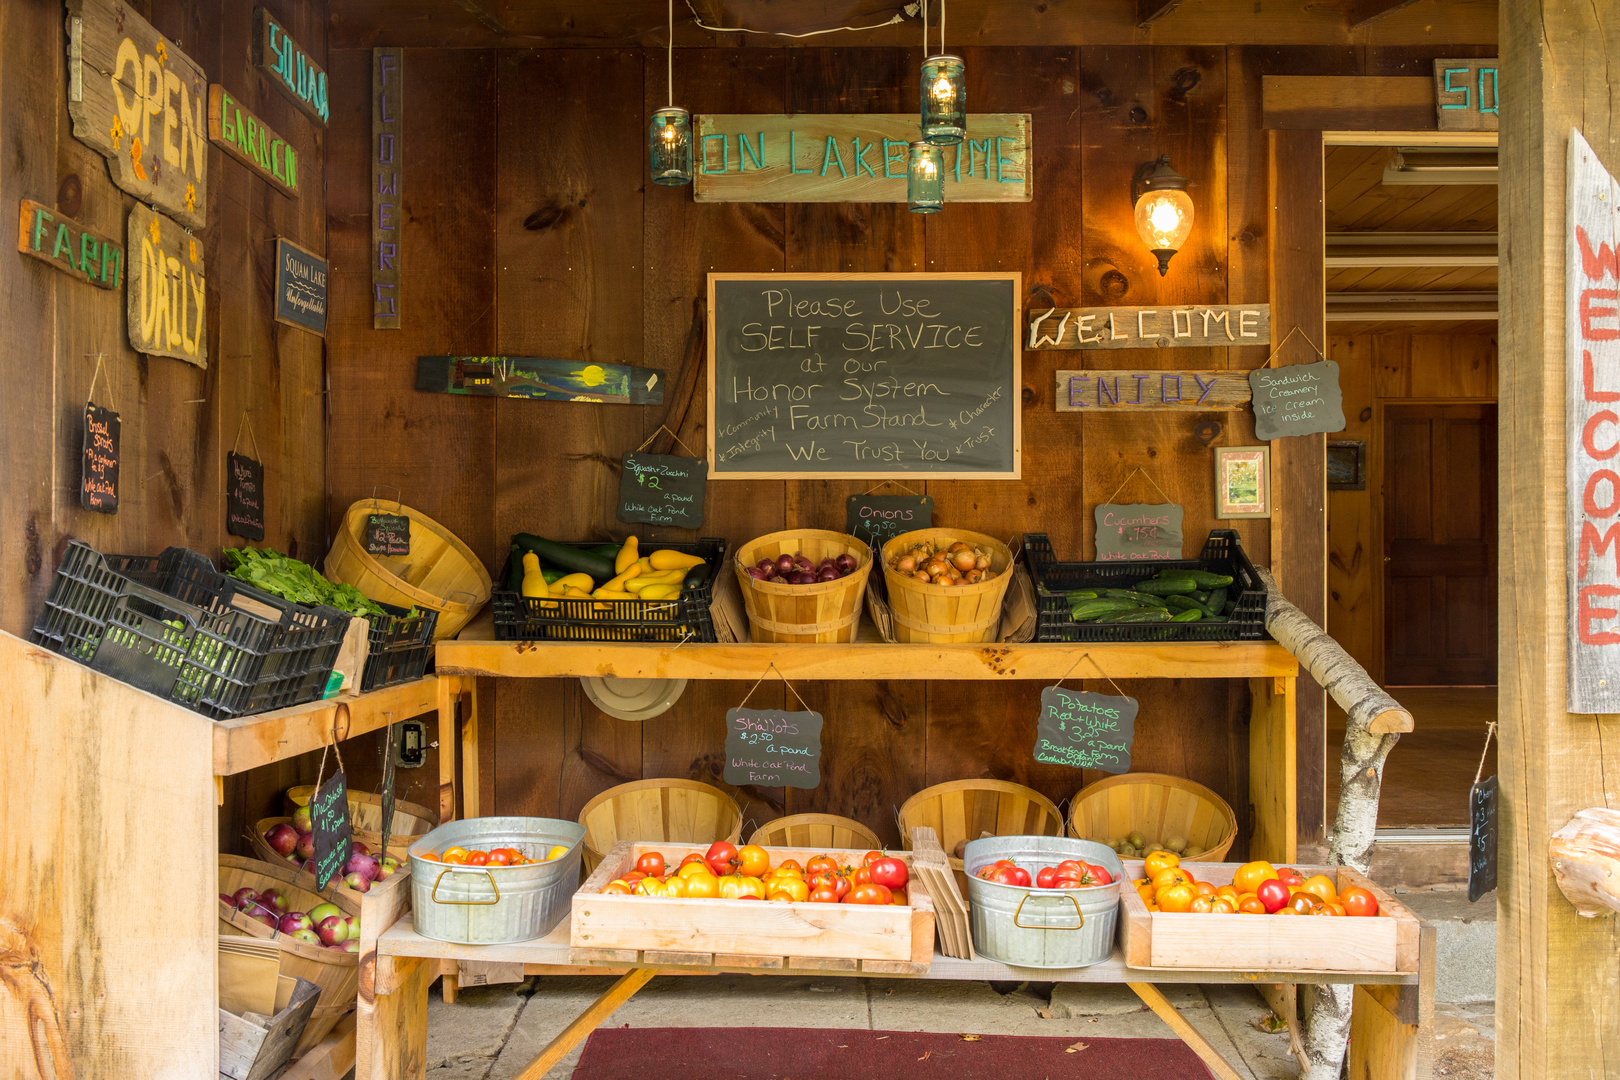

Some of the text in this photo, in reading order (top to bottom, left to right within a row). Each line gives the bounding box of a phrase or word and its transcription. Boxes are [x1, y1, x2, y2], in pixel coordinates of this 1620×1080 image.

[1442, 68, 1498, 115] SQ
[112, 37, 201, 183] OPEN
[222, 93, 299, 188] GARDEN
[702, 130, 1024, 183] ON LAKE IME
[376, 56, 396, 317] FLOWERS
[34, 209, 120, 287] FARM
[141, 236, 205, 356] DAILY
[762, 287, 941, 318] Please Use
[741, 323, 984, 352] SELF SERVICE
[1029, 307, 1261, 349] WELCOME
[800, 353, 828, 373] at
[734, 376, 951, 409] Honor System
[1069, 374, 1218, 407] ENJOY
[1259, 372, 1320, 388] Sandwich
[1269, 385, 1318, 398] Creamery
[789, 405, 944, 430] Farm Stand
[959, 386, 1003, 426] Character
[1261, 404, 1277, 414] ice
[1281, 411, 1315, 421] inside
[726, 405, 778, 437] Community
[726, 426, 777, 460] Integrity
[786, 439, 950, 461] We Trust You
[964, 425, 996, 450] Trust
[624, 503, 645, 511] White
[648, 505, 662, 513] Oak
[859, 506, 914, 520] Onions
[1103, 512, 1170, 526] Cucumbers
[1101, 550, 1176, 561] White Oak Pond
[1056, 693, 1120, 719] Potatoes
[734, 717, 799, 735] Shallots
[1048, 706, 1078, 721] Red
[1085, 715, 1121, 732] White
[766, 744, 778, 753] a
[1091, 749, 1119, 764] Farm
[732, 757, 812, 774] White Oak Pond
[749, 771, 780, 781] Farm
